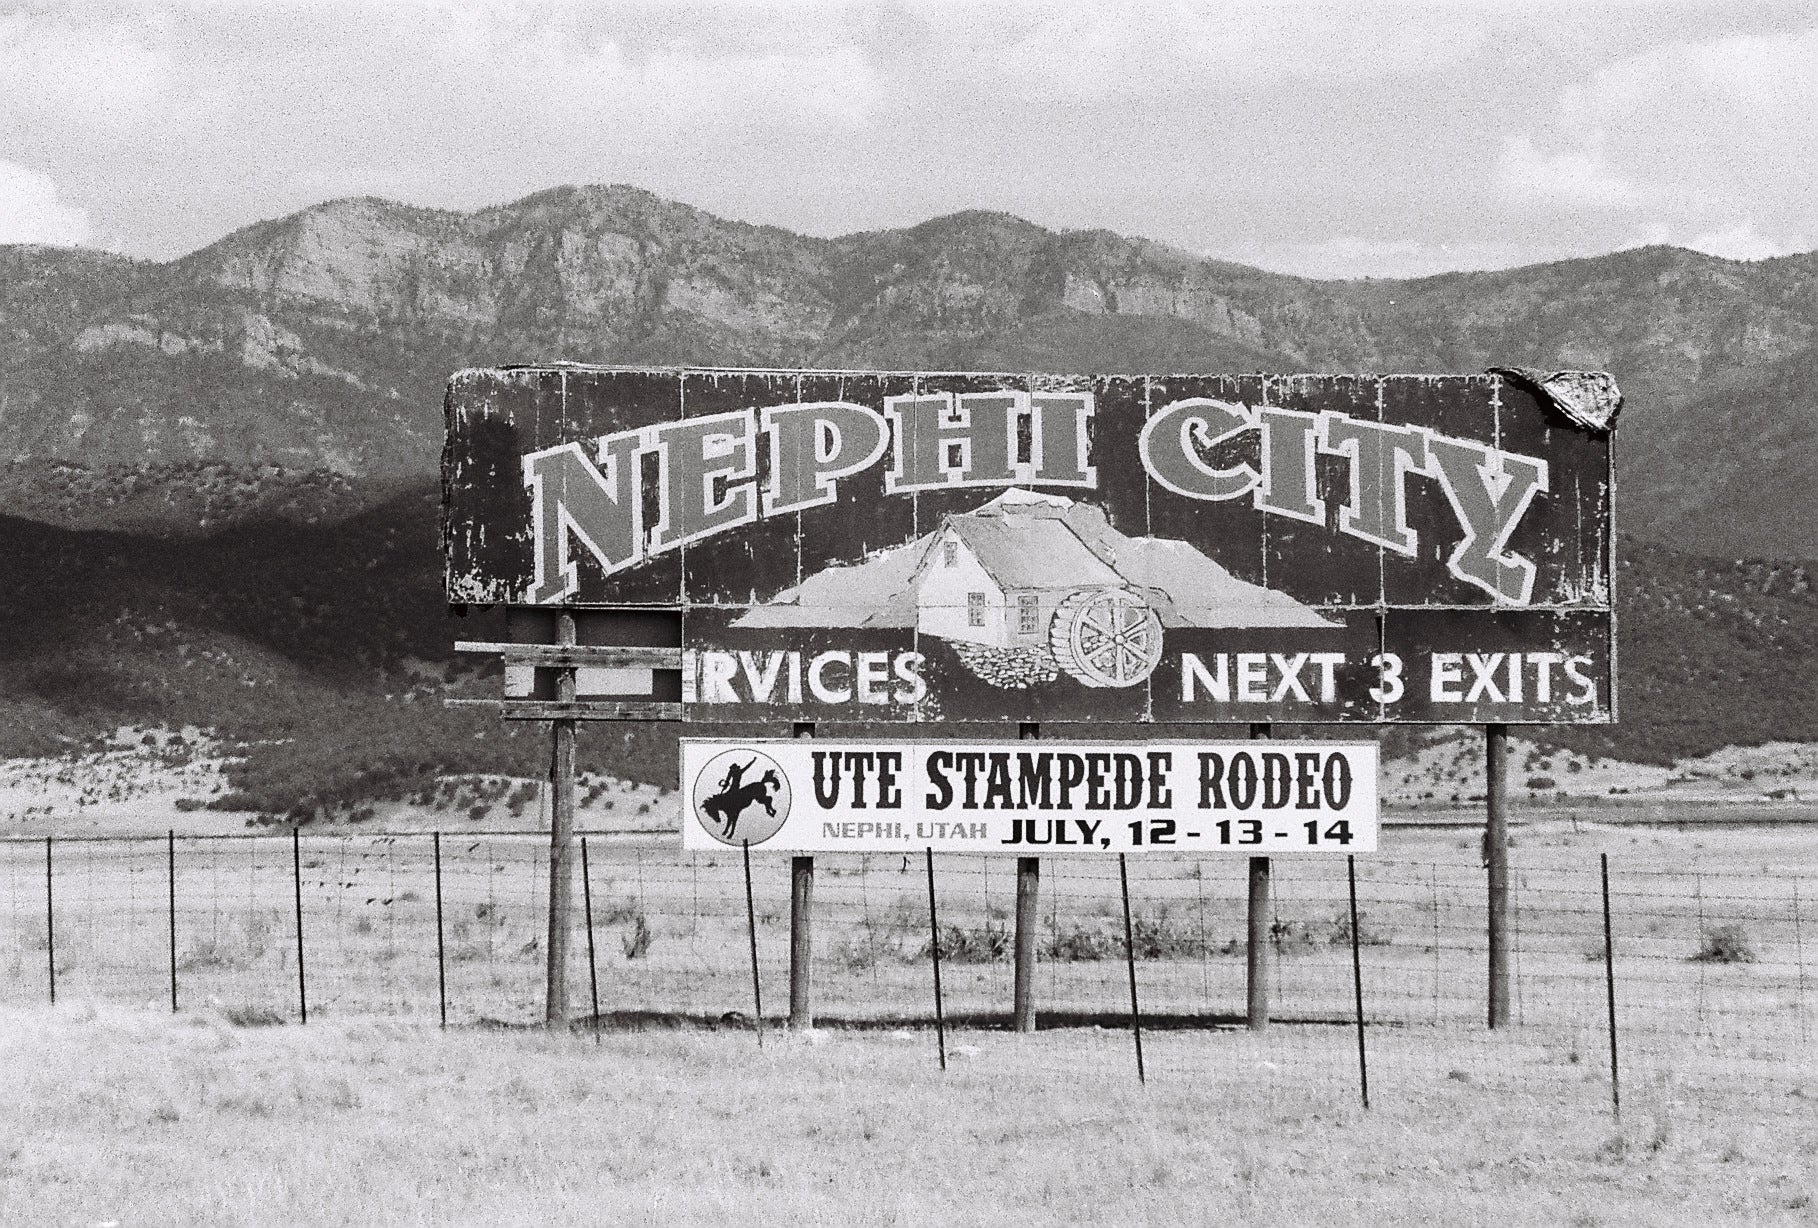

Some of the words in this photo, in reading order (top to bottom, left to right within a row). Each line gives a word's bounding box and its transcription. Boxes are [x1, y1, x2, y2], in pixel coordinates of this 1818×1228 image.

[523, 392, 1097, 604] NEPHI
[1138, 397, 1549, 605] CITY
[1181, 652, 1345, 703] NEXT
[1369, 651, 1405, 704] 3
[1430, 651, 1598, 705] EXITS
[811, 751, 902, 809] UTE
[926, 750, 1172, 811] STAMPEDE
[1197, 751, 1353, 811] RODEO
[822, 822, 911, 841] NEPHI,
[916, 822, 988, 840] UTAH
[1001, 819, 1112, 850] JULY,
